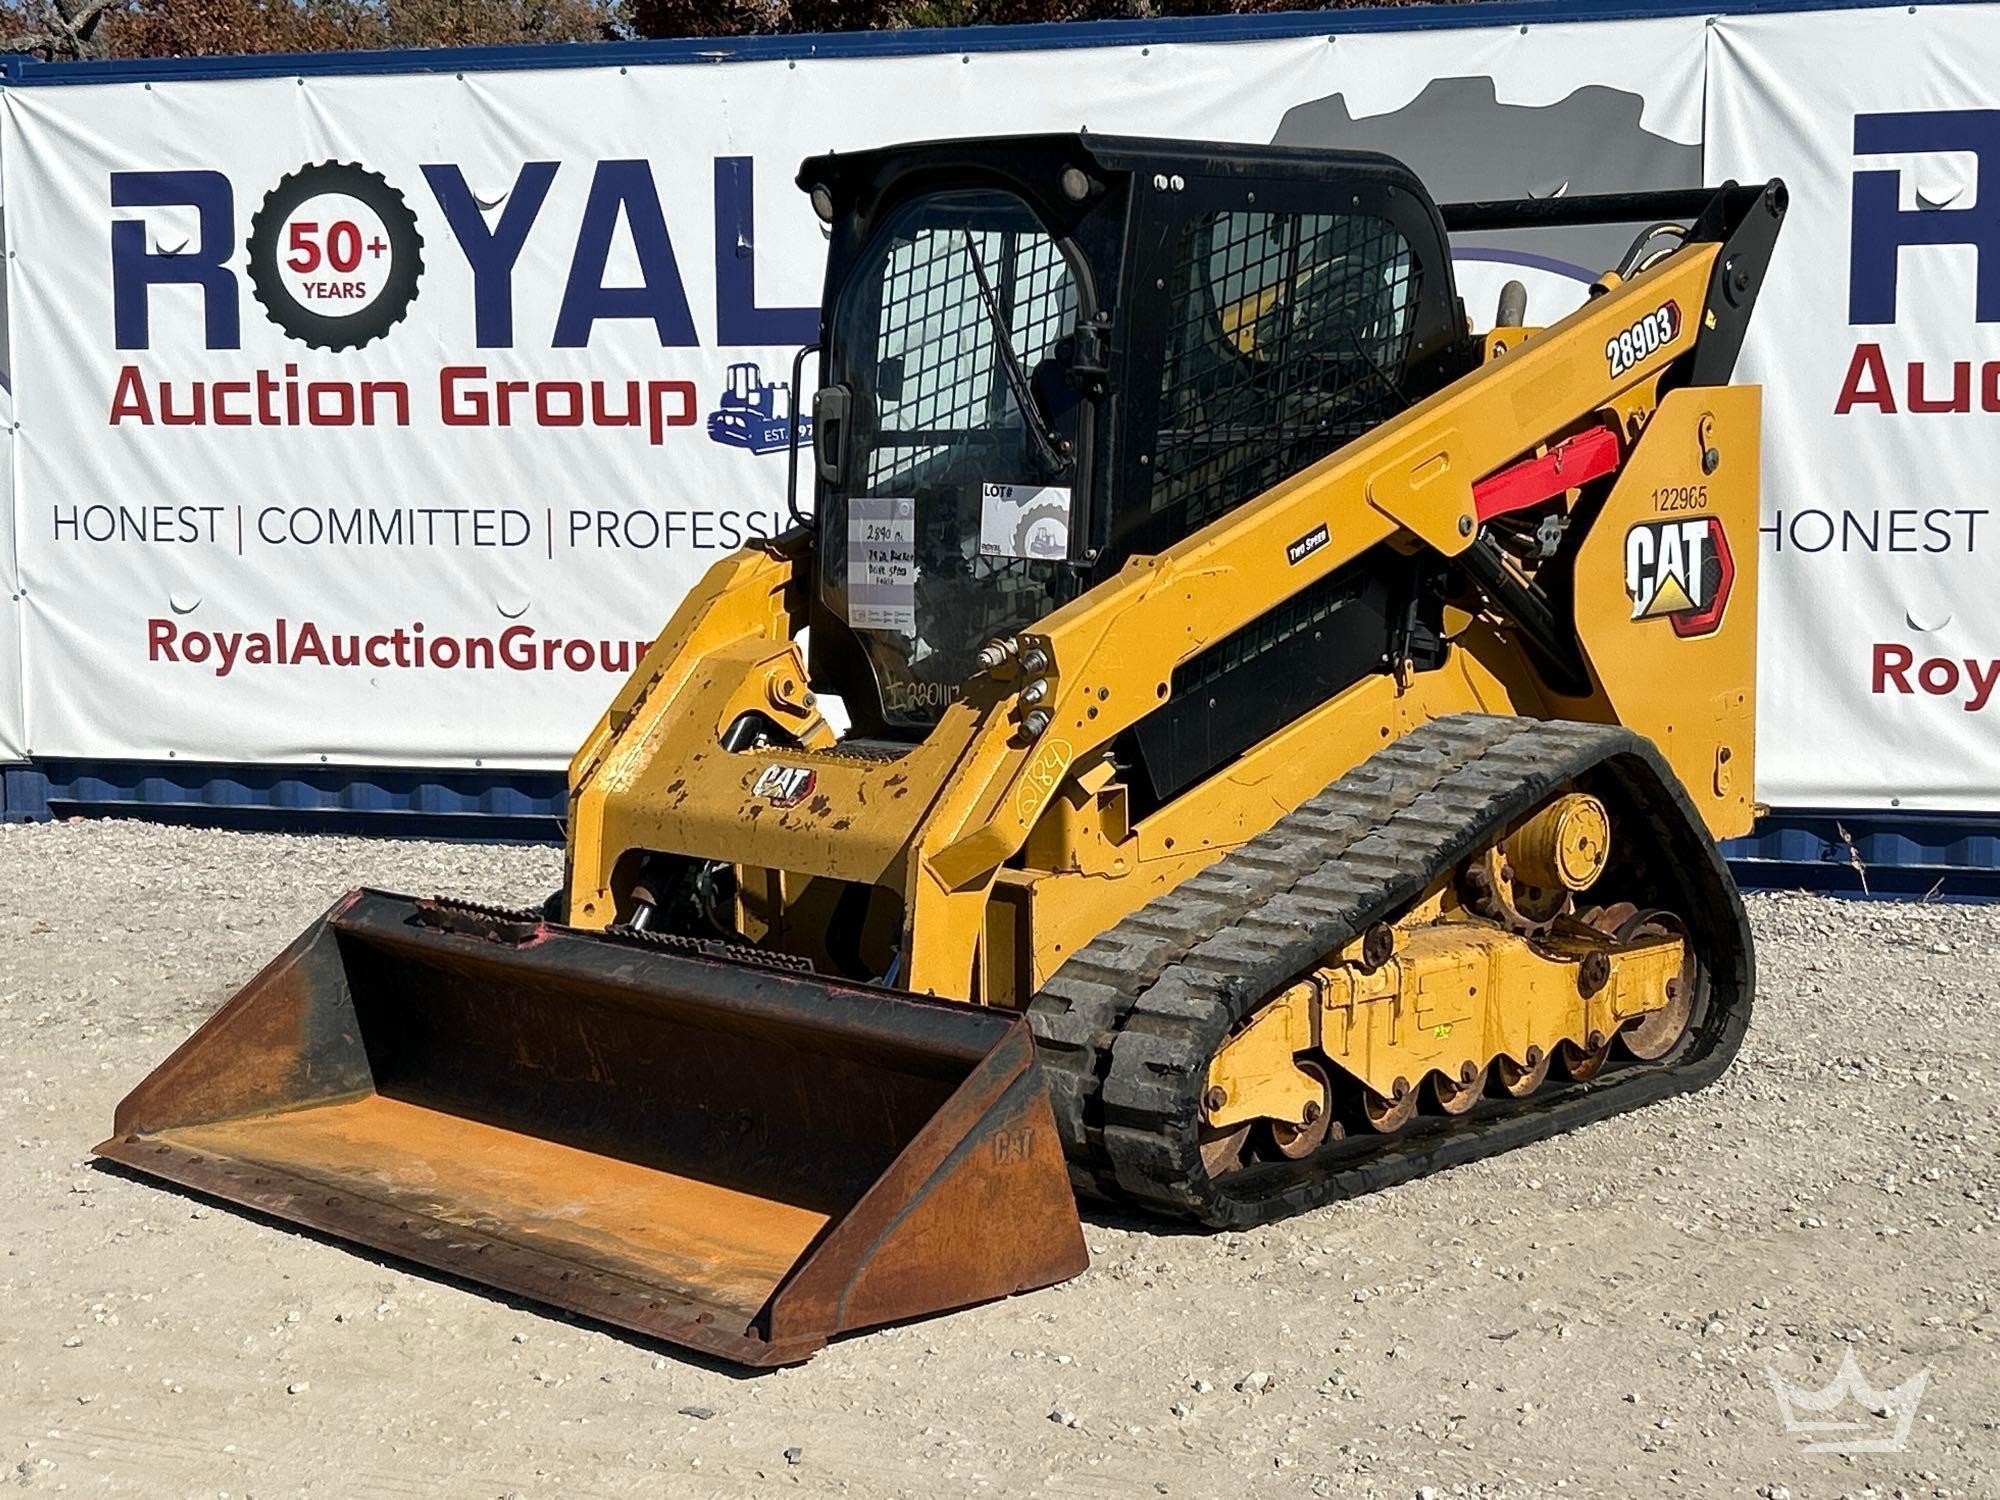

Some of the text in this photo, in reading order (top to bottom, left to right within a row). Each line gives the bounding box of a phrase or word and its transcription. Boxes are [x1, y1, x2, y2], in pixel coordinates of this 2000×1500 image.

[287, 220, 388, 274] 50+
[303, 282, 367, 299] YEARS
[1606, 306, 1672, 378] 289D3
[109, 363, 698, 445] Auction Group
[764, 427, 788, 442] EST.
[984, 484, 1013, 498] LOT#
[1651, 485, 1708, 512] 122965
[54, 504, 225, 543] HONEST
[258, 507, 531, 546] COMMITTED
[1627, 519, 1710, 620] CAT
[752, 764, 811, 800] CAT
